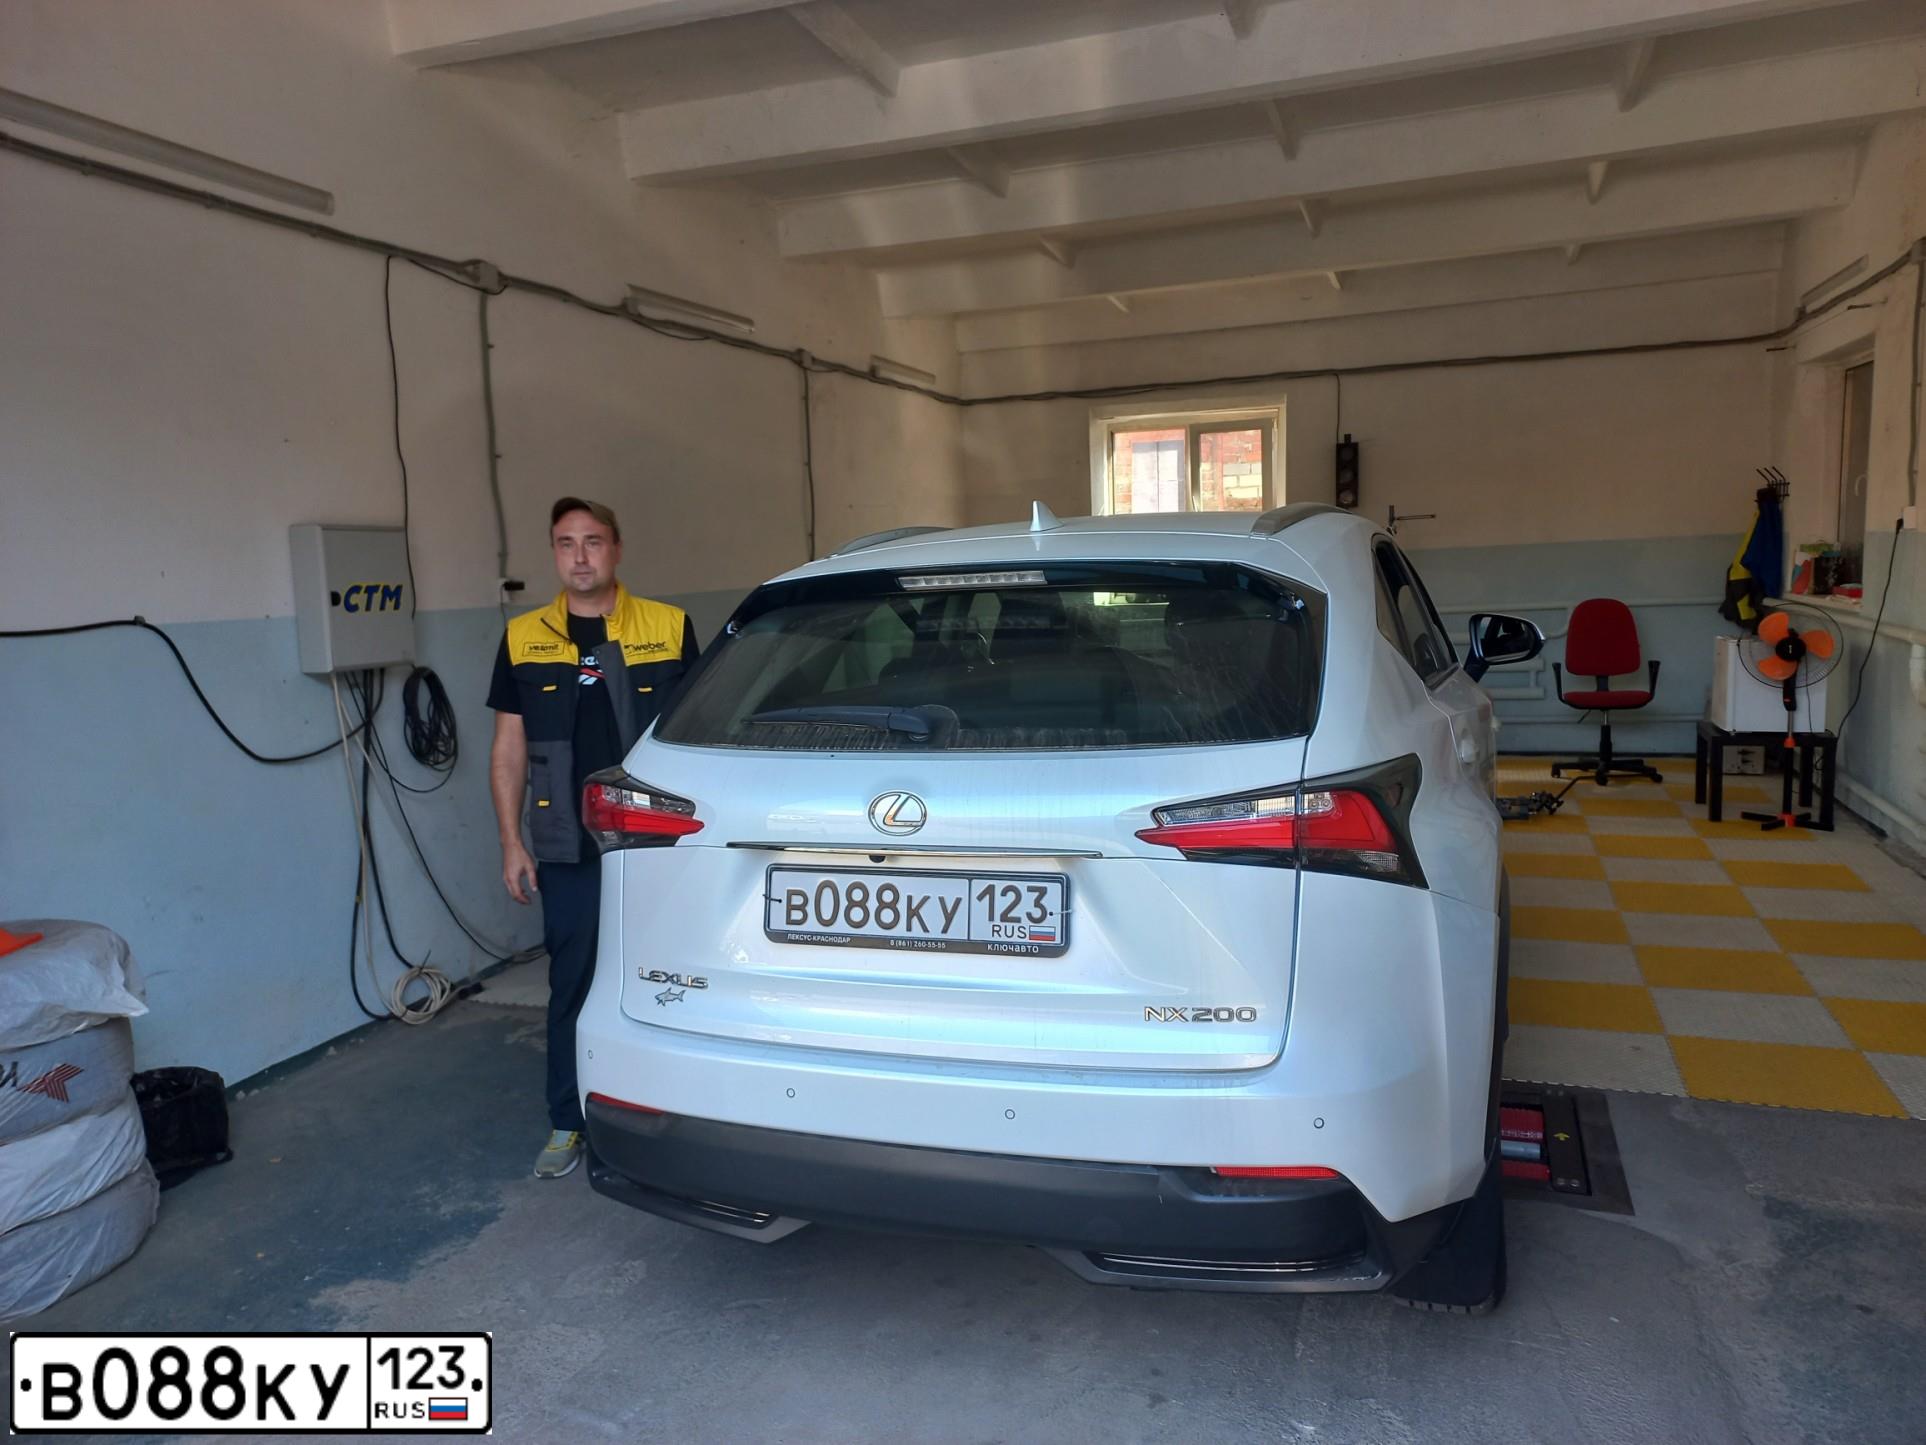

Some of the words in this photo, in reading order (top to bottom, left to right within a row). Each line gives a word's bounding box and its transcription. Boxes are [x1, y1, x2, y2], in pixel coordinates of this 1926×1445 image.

[976, 883, 1048, 924] 123
[991, 923, 1027, 939] RUS
[638, 967, 709, 989] LEXUS
